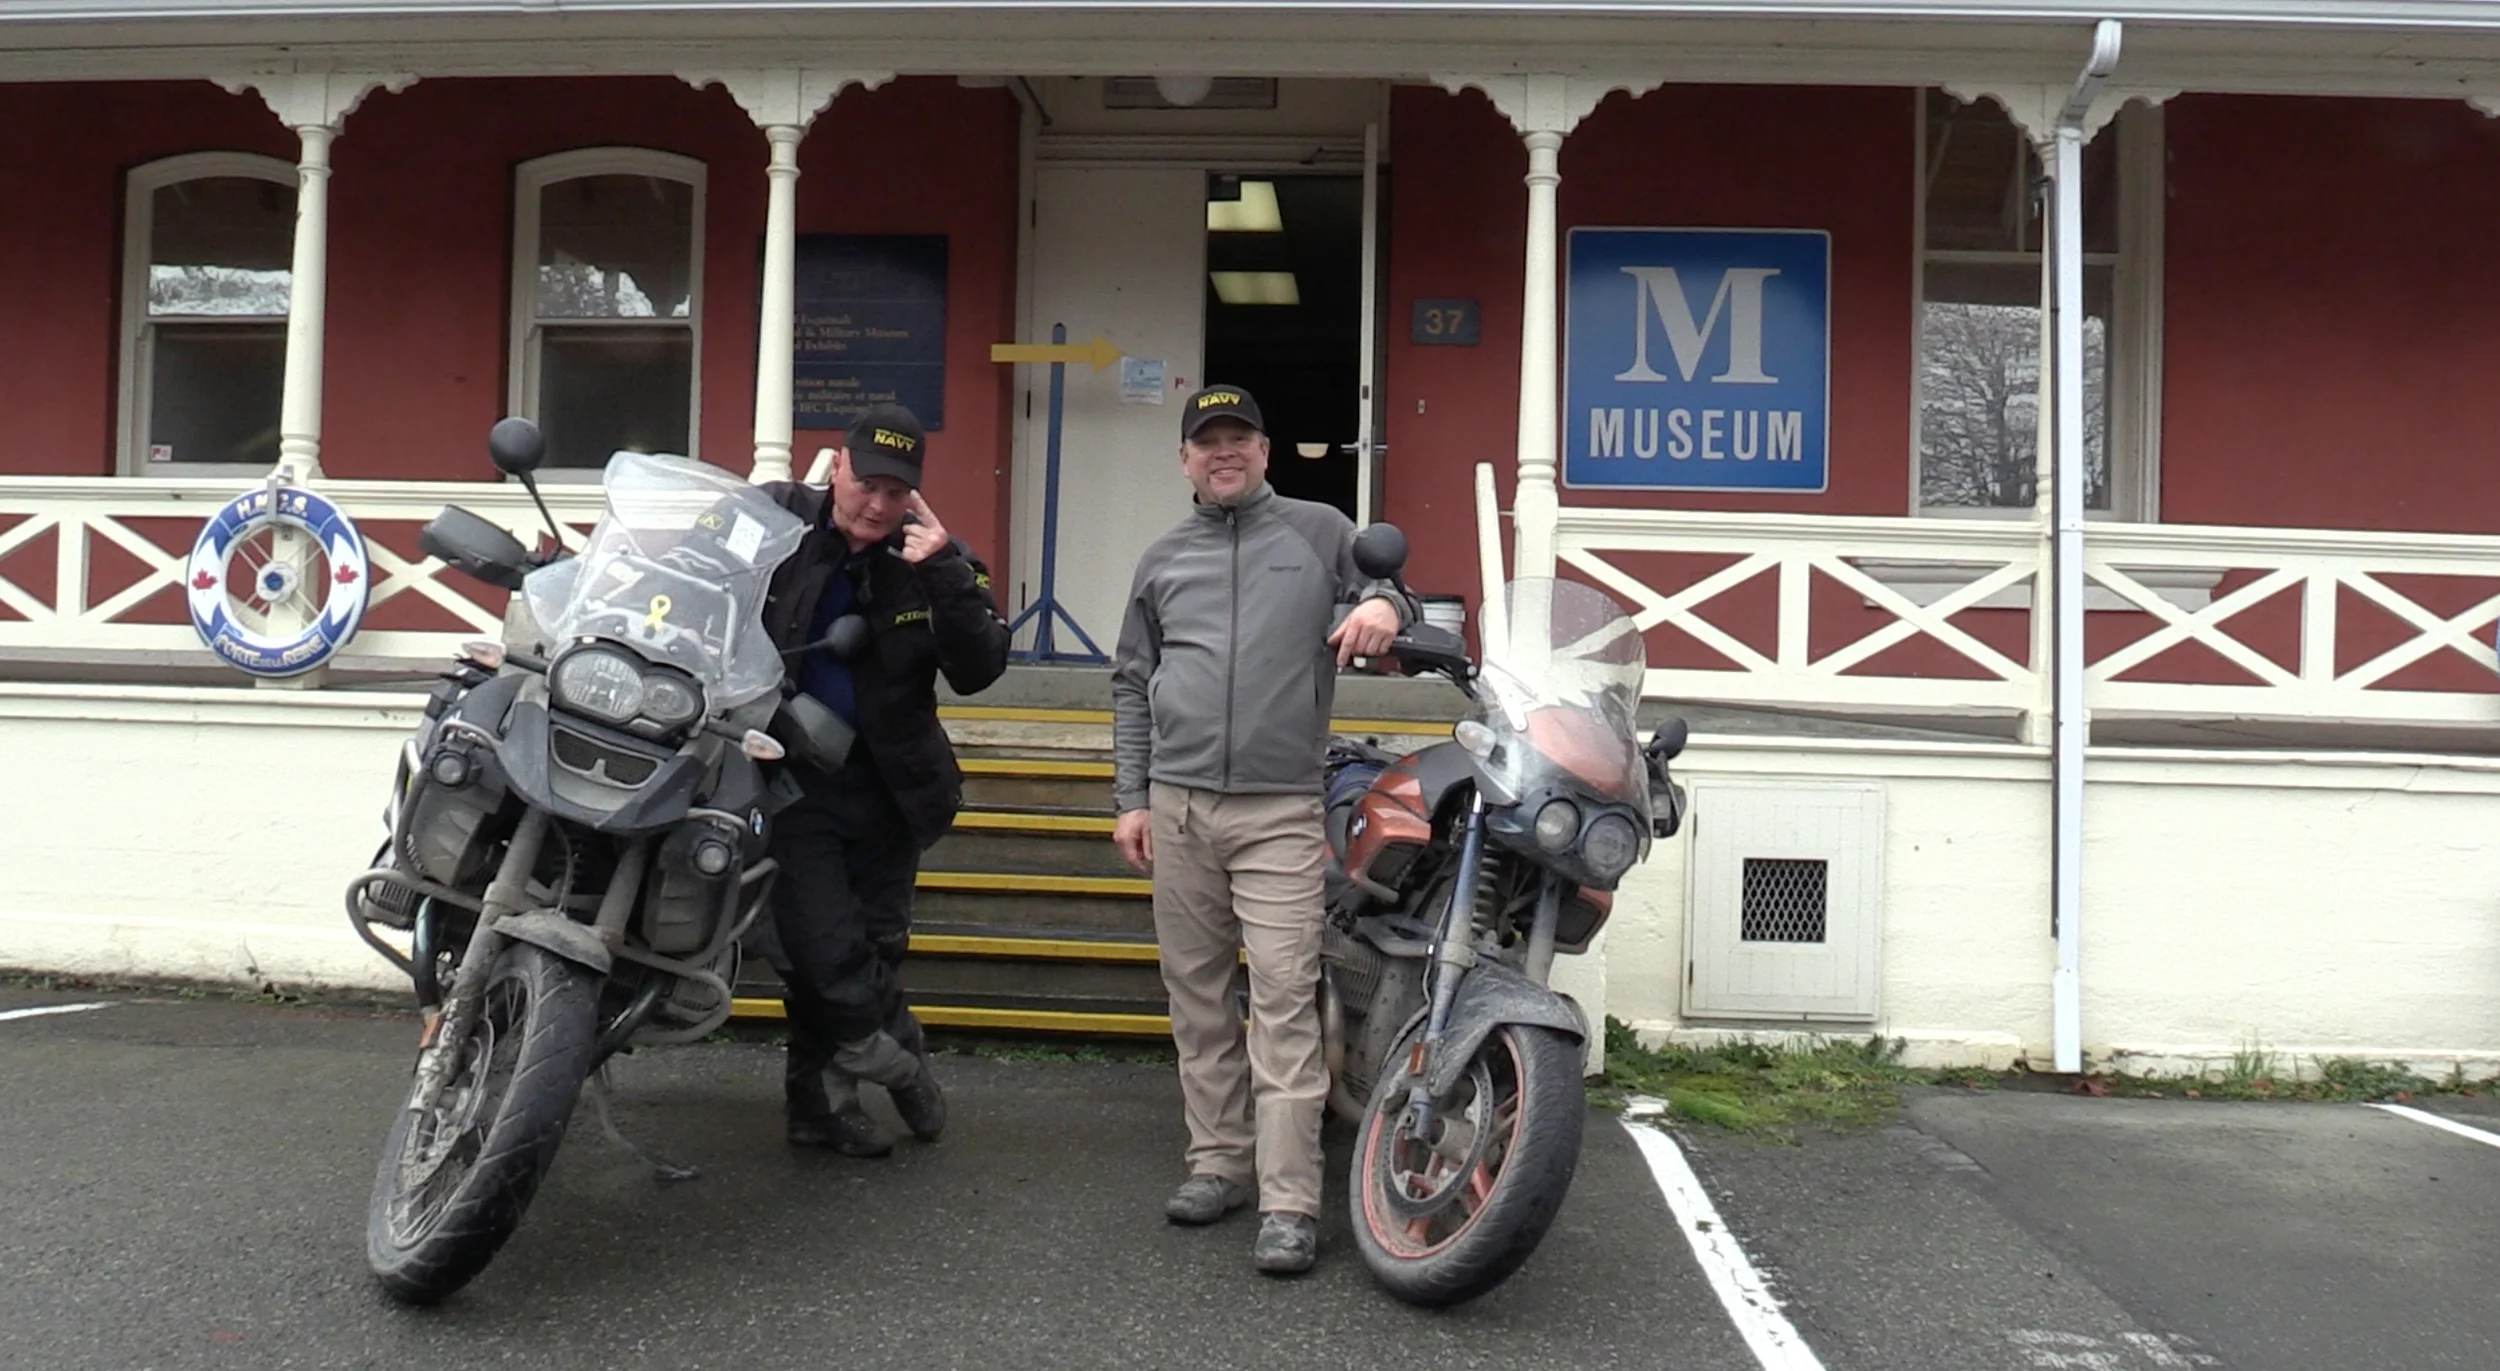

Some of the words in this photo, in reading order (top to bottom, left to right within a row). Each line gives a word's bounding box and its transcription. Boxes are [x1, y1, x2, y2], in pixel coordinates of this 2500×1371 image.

[1424, 309, 1464, 334] 37
[1615, 266, 1781, 383] M
[1198, 394, 1240, 409] NAVY
[874, 431, 915, 451] NAVY
[1590, 408, 1802, 461] MUSEUM
